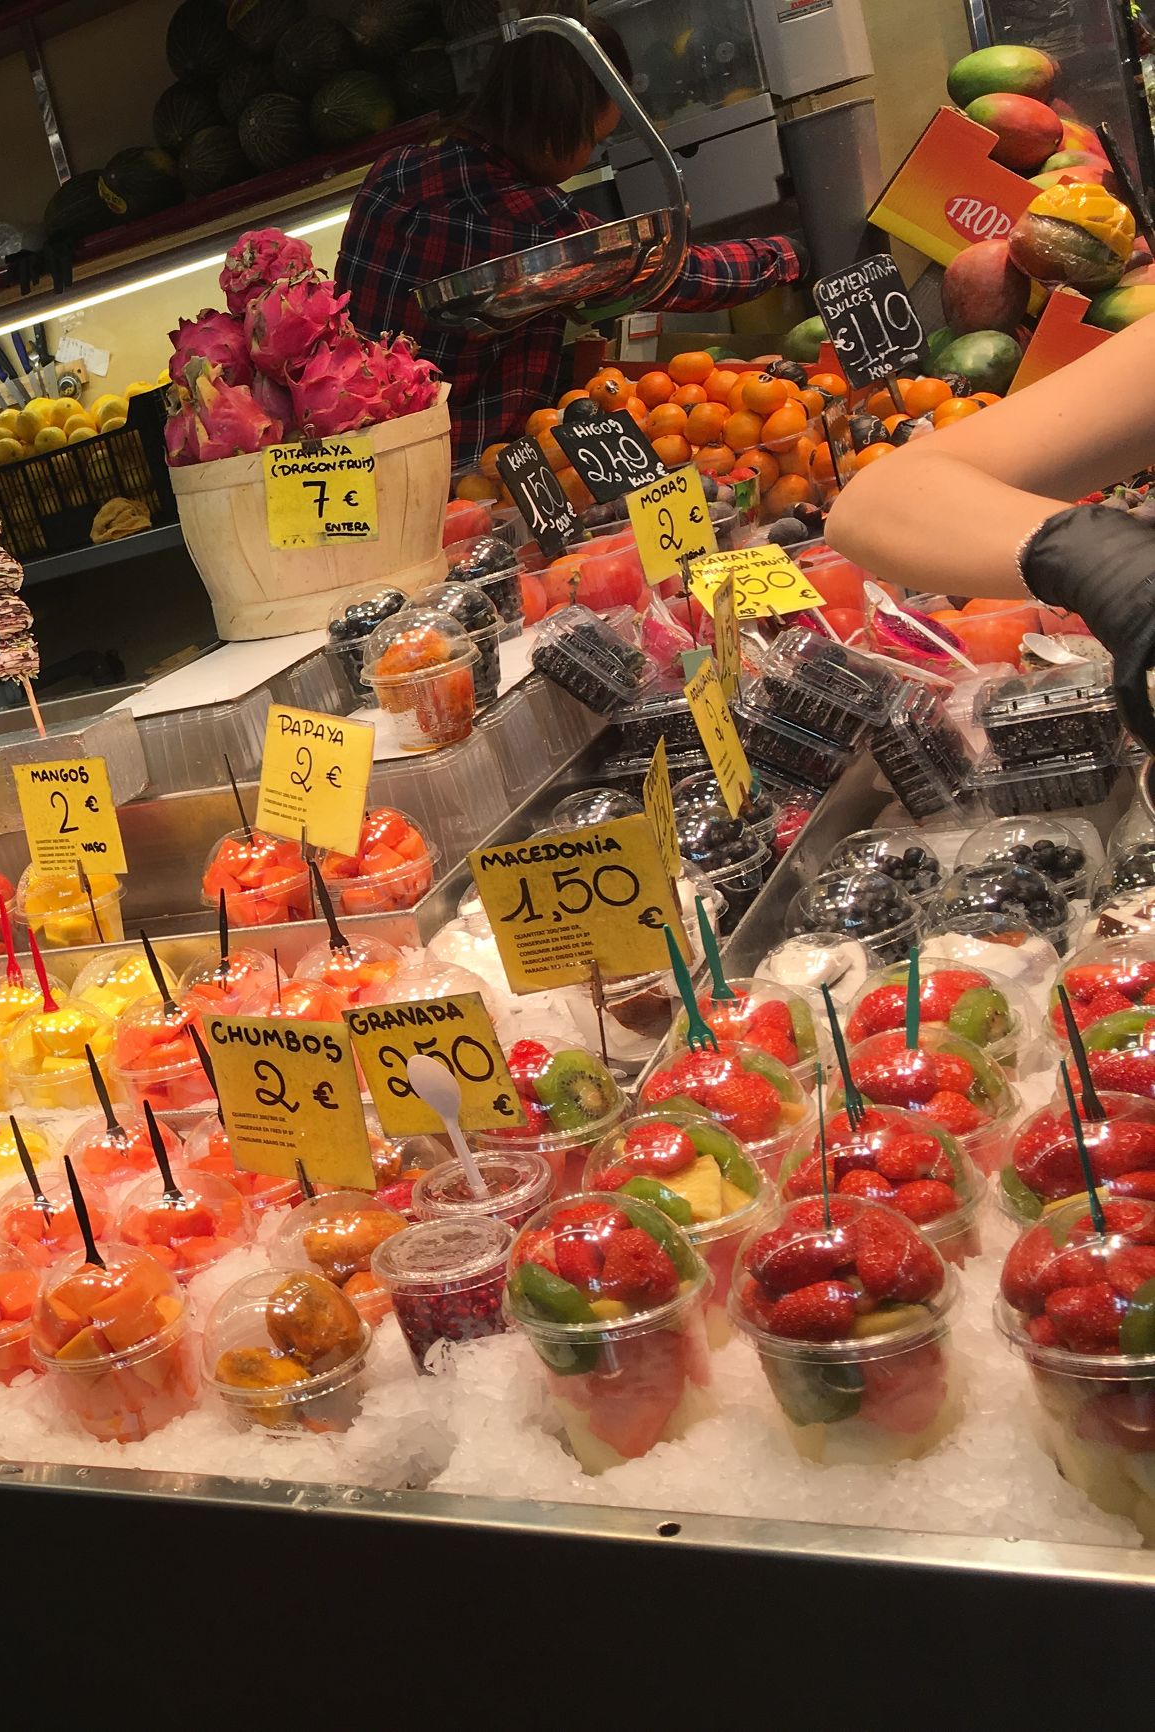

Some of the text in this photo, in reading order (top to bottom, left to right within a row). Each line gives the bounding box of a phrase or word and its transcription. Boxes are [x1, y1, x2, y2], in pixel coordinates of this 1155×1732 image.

[824, 287, 874, 320] DULCES
[302, 480, 359, 519] 7 €
[640, 475, 688, 510] MORAS
[324, 521, 371, 532] ENTERA
[657, 505, 704, 551] 2 €
[799, 588, 818, 599] €
[278, 714, 344, 747] PAPAYA
[30, 766, 90, 784] MANGOS
[290, 746, 342, 794] 2 €
[50, 791, 100, 834] 2 €
[81, 841, 107, 854] VASO
[500, 864, 666, 930] 1,50 €
[348, 1002, 465, 1036] GRANADA
[210, 1020, 343, 1064] CHUMBOS
[253, 1059, 340, 1113] 2 €
[492, 1094, 514, 1116] €
